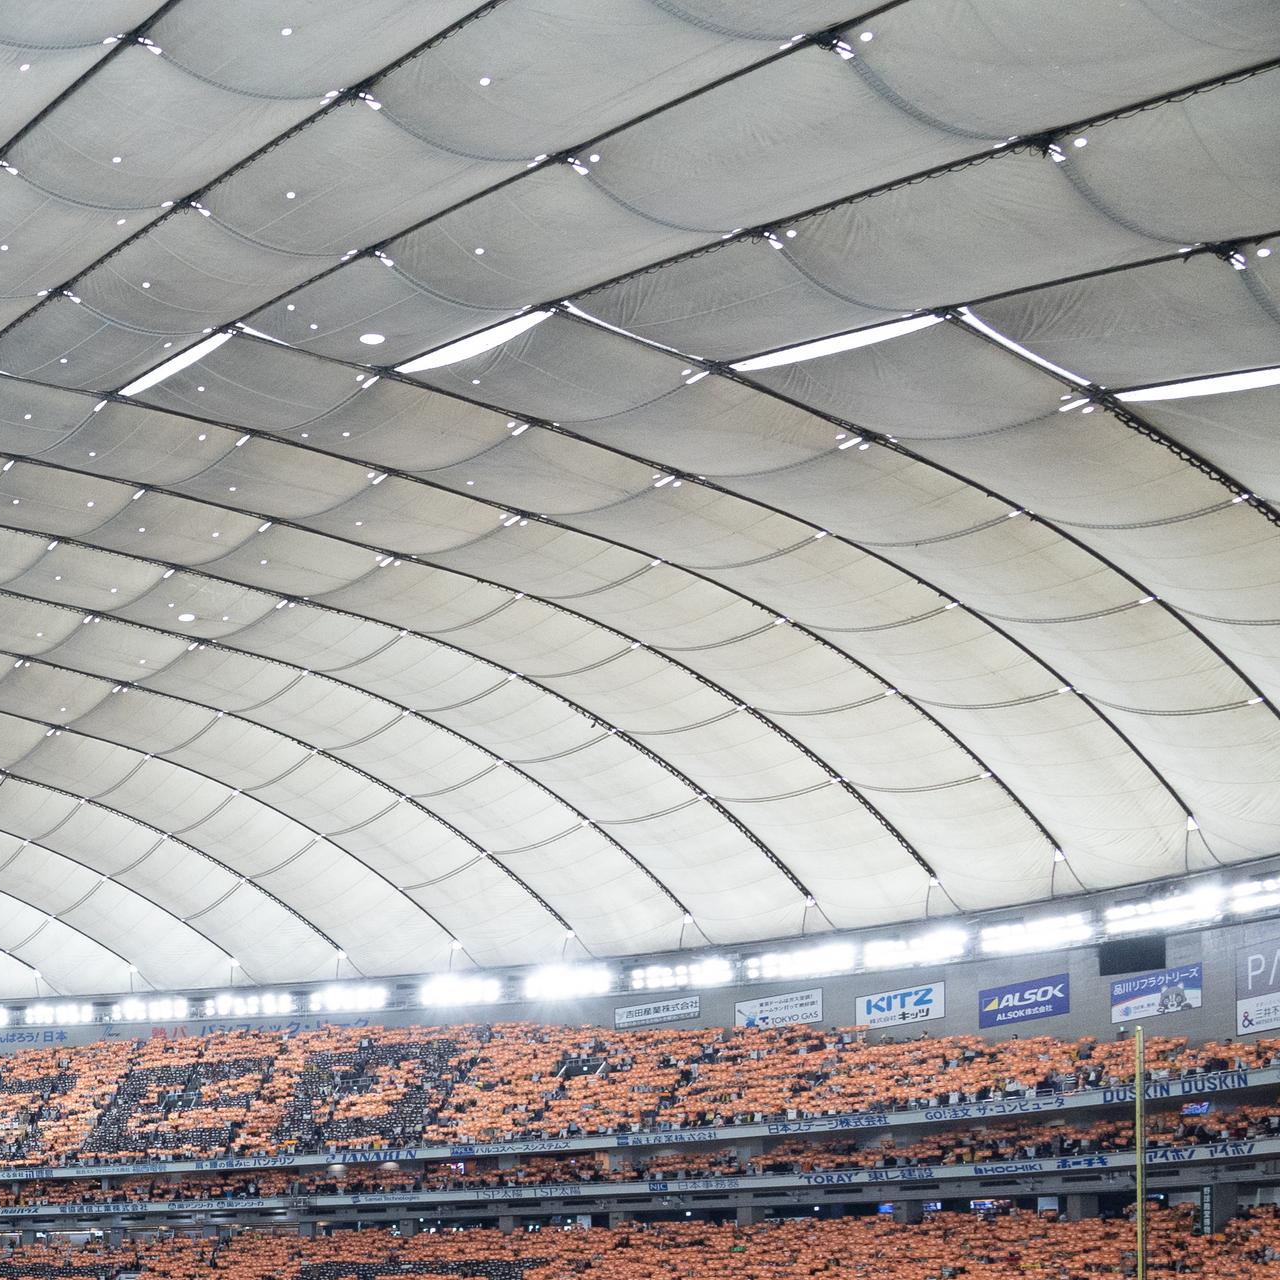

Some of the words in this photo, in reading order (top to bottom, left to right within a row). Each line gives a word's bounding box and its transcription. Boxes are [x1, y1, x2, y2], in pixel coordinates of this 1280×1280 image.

[1113, 966, 1199, 996] 品川リフラクトリーズ
[865, 987, 934, 1016] KITZ
[1000, 983, 1065, 1009] ALSOK
[625, 999, 700, 1020] 吉田産業株式会社
[869, 1014, 897, 1025] 株式会社
[898, 1008, 930, 1020] キッツ
[996, 1005, 1053, 1022] ALSOK株式会社
[771, 1013, 800, 1025] TOKYO
[801, 1012, 819, 1021] GAS
[42, 1030, 68, 1043] 日本
[924, 1107, 972, 1121] GO!注文
[976, 1096, 1065, 1116] ザ・コンピュータ
[768, 1113, 889, 1135] 日本ステージ株式会社
[631, 1131, 718, 1146] 蔵王産業株式会社
[475, 1141, 571, 1154] パルコスペースシステムズ
[1147, 1148, 1196, 1163] アイホン
[1209, 1142, 1256, 1158] アイホン
[983, 1162, 1044, 1175] HOCHIKI
[1056, 1155, 1109, 1169] ホーチキ
[868, 1168, 935, 1182] 東レ建設
[475, 1189, 523, 1200] TSP太陽
[532, 1186, 581, 1196] TSP太陽
[649, 1182, 667, 1191] NJC
[677, 1180, 739, 1191] 日本事務器
